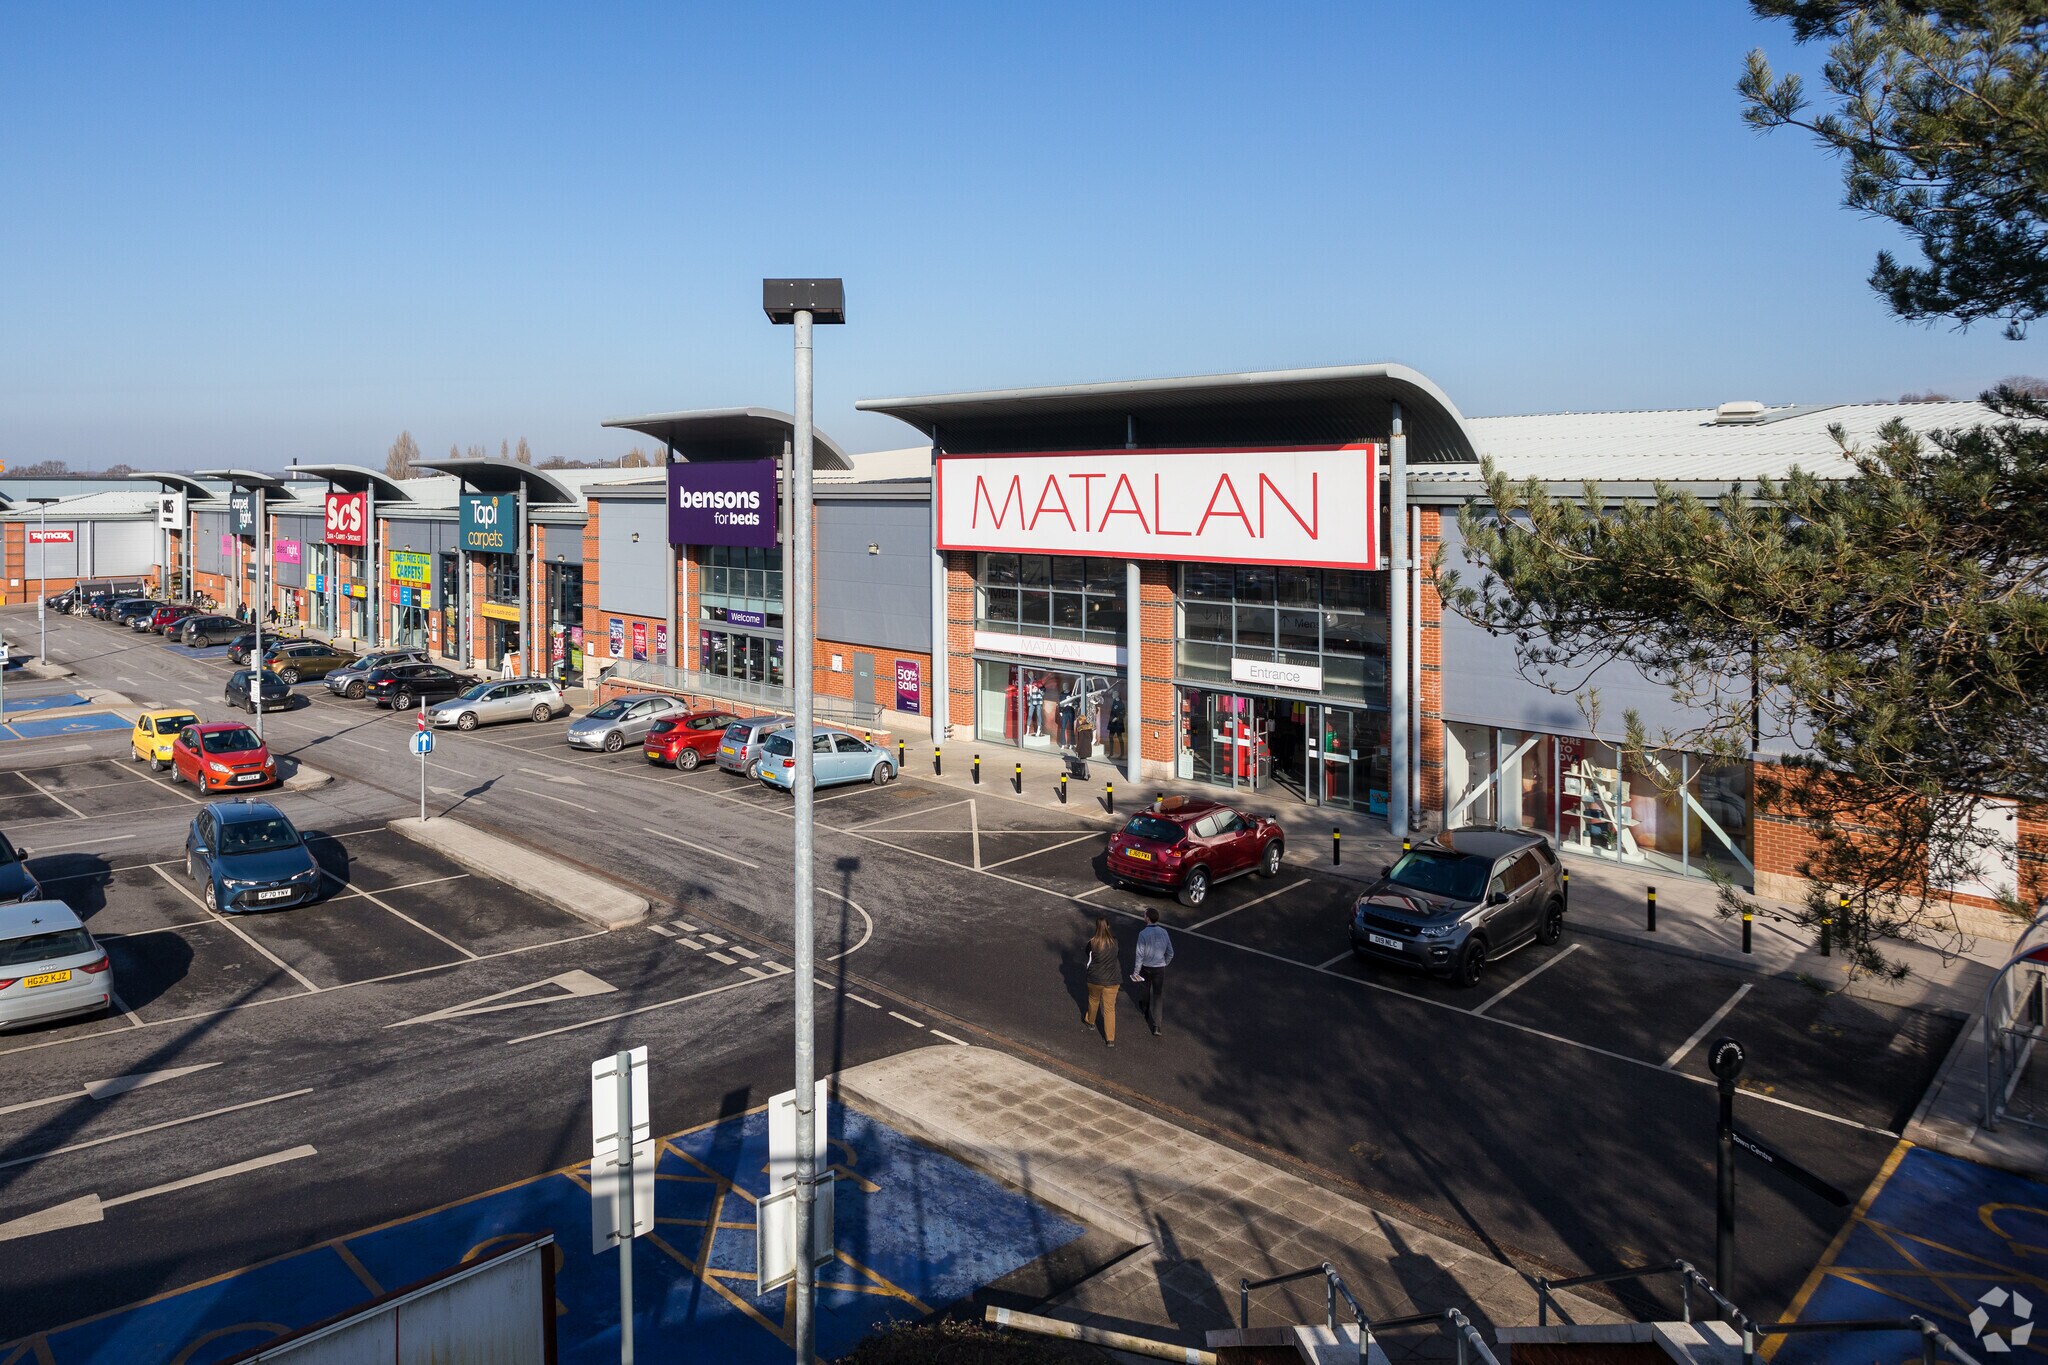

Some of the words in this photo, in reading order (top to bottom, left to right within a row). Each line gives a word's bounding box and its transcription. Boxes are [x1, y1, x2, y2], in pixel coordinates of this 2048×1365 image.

[680, 485, 760, 511] bensons
[972, 472, 1318, 540] MATALAN
[327, 496, 361, 532] ScS
[470, 497, 499, 530] Tapi
[714, 511, 729, 525] for
[729, 512, 760, 526] beds
[467, 529, 504, 549] carpets
[731, 612, 760, 624] Welcome
[1021, 639, 1081, 658] MATALAN
[898, 669, 917, 681] 50%
[1250, 665, 1300, 683] Entrance
[898, 681, 918, 692] sale
[27, 976, 49, 986] HG22
[50, 972, 67, 982] KJZ
[1715, 1042, 1743, 1065] WATERLOOVILLE
[1731, 1132, 1750, 1149] Town
[1750, 1144, 1773, 1163] Centre
